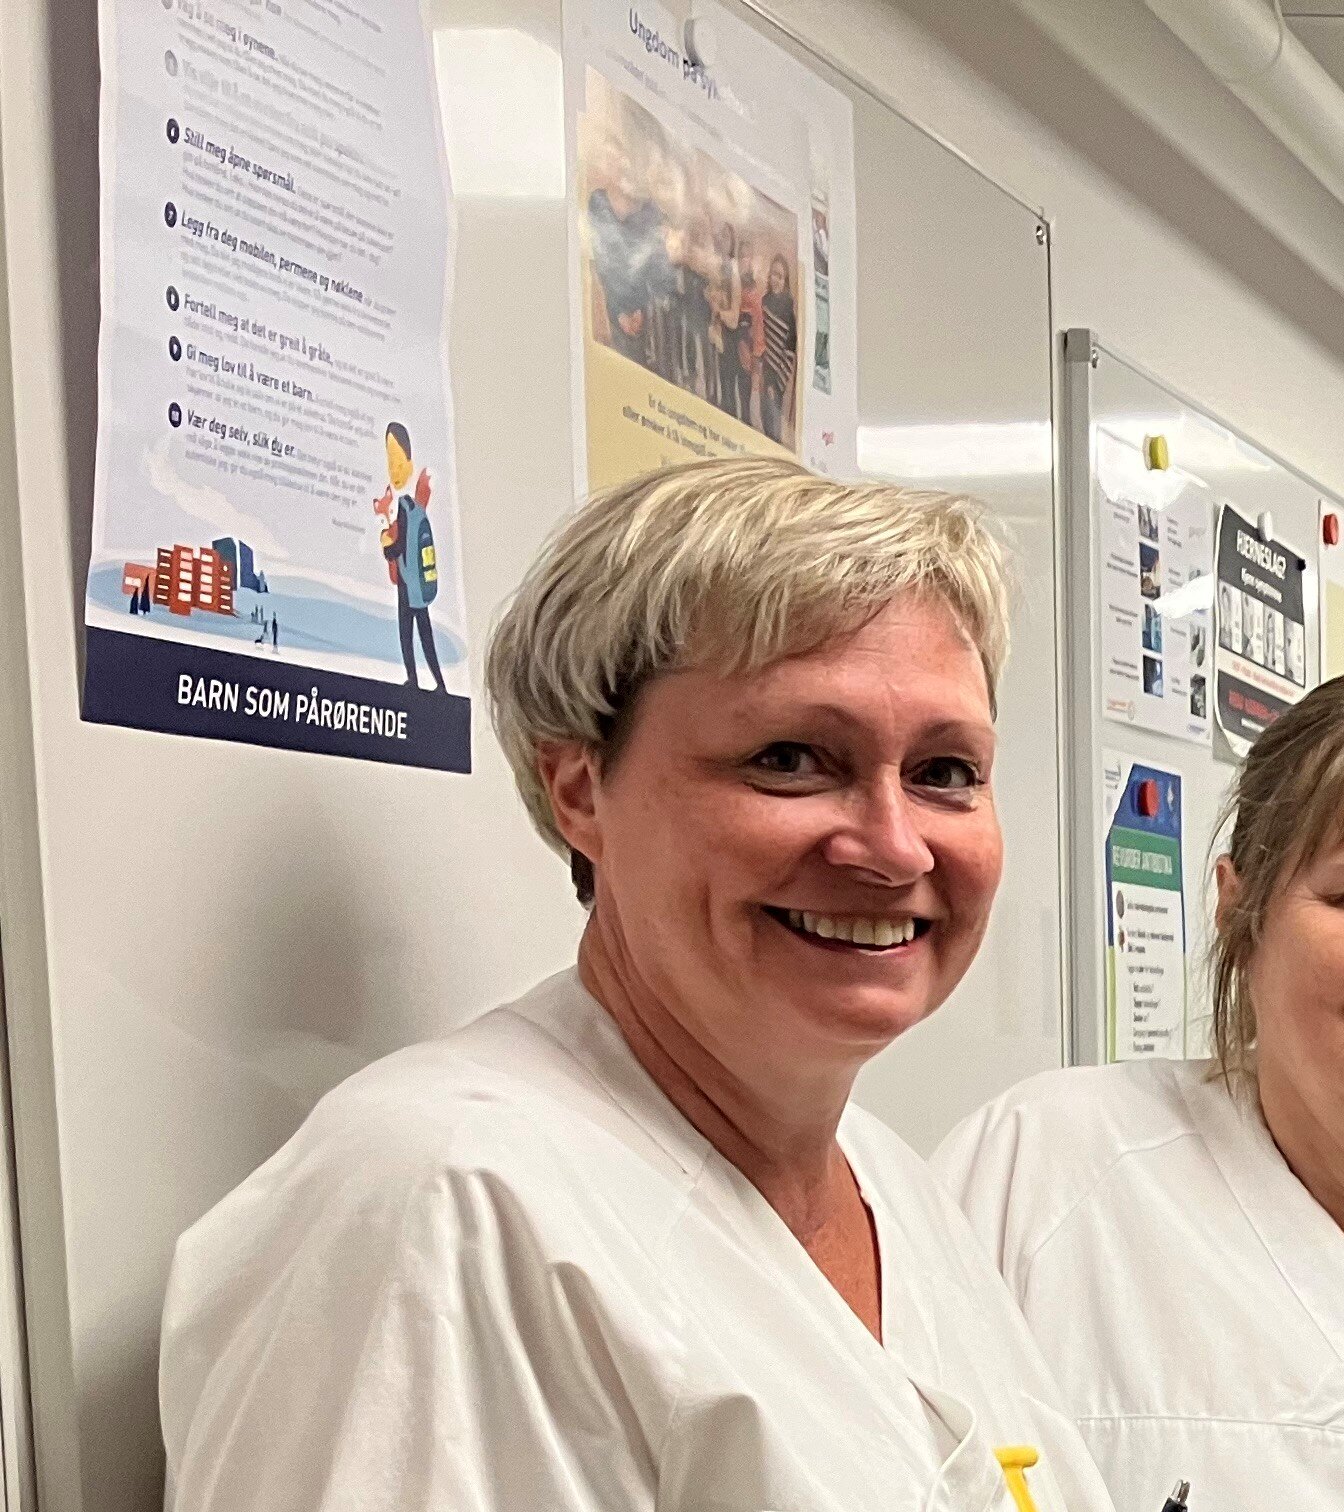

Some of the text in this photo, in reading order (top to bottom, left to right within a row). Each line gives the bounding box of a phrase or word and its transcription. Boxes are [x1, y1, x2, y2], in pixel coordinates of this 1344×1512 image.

[630, 8, 680, 70] Ungdom
[206, 141, 226, 164] meg
[181, 210, 205, 238] Legg
[206, 221, 220, 241] fra
[221, 229, 238, 252] deg
[319, 274, 330, 292] og
[184, 293, 217, 320] Fortell
[218, 310, 239, 332] meg
[240, 318, 250, 333] at
[251, 320, 266, 339] det
[268, 329, 278, 342] er
[186, 343, 197, 361] Gi
[198, 350, 219, 373] meg
[221, 355, 236, 374] lov
[237, 361, 247, 379] til
[249, 362, 255, 382] å
[256, 370, 280, 391] være
[281, 380, 290, 394] et
[187, 408, 207, 429] Vær
[208, 416, 227, 439] deg
[228, 425, 251, 446] selv,
[252, 430, 270, 450] slik
[271, 435, 283, 456] du
[177, 673, 408, 740] BARN SOM PÅRØRENDE
